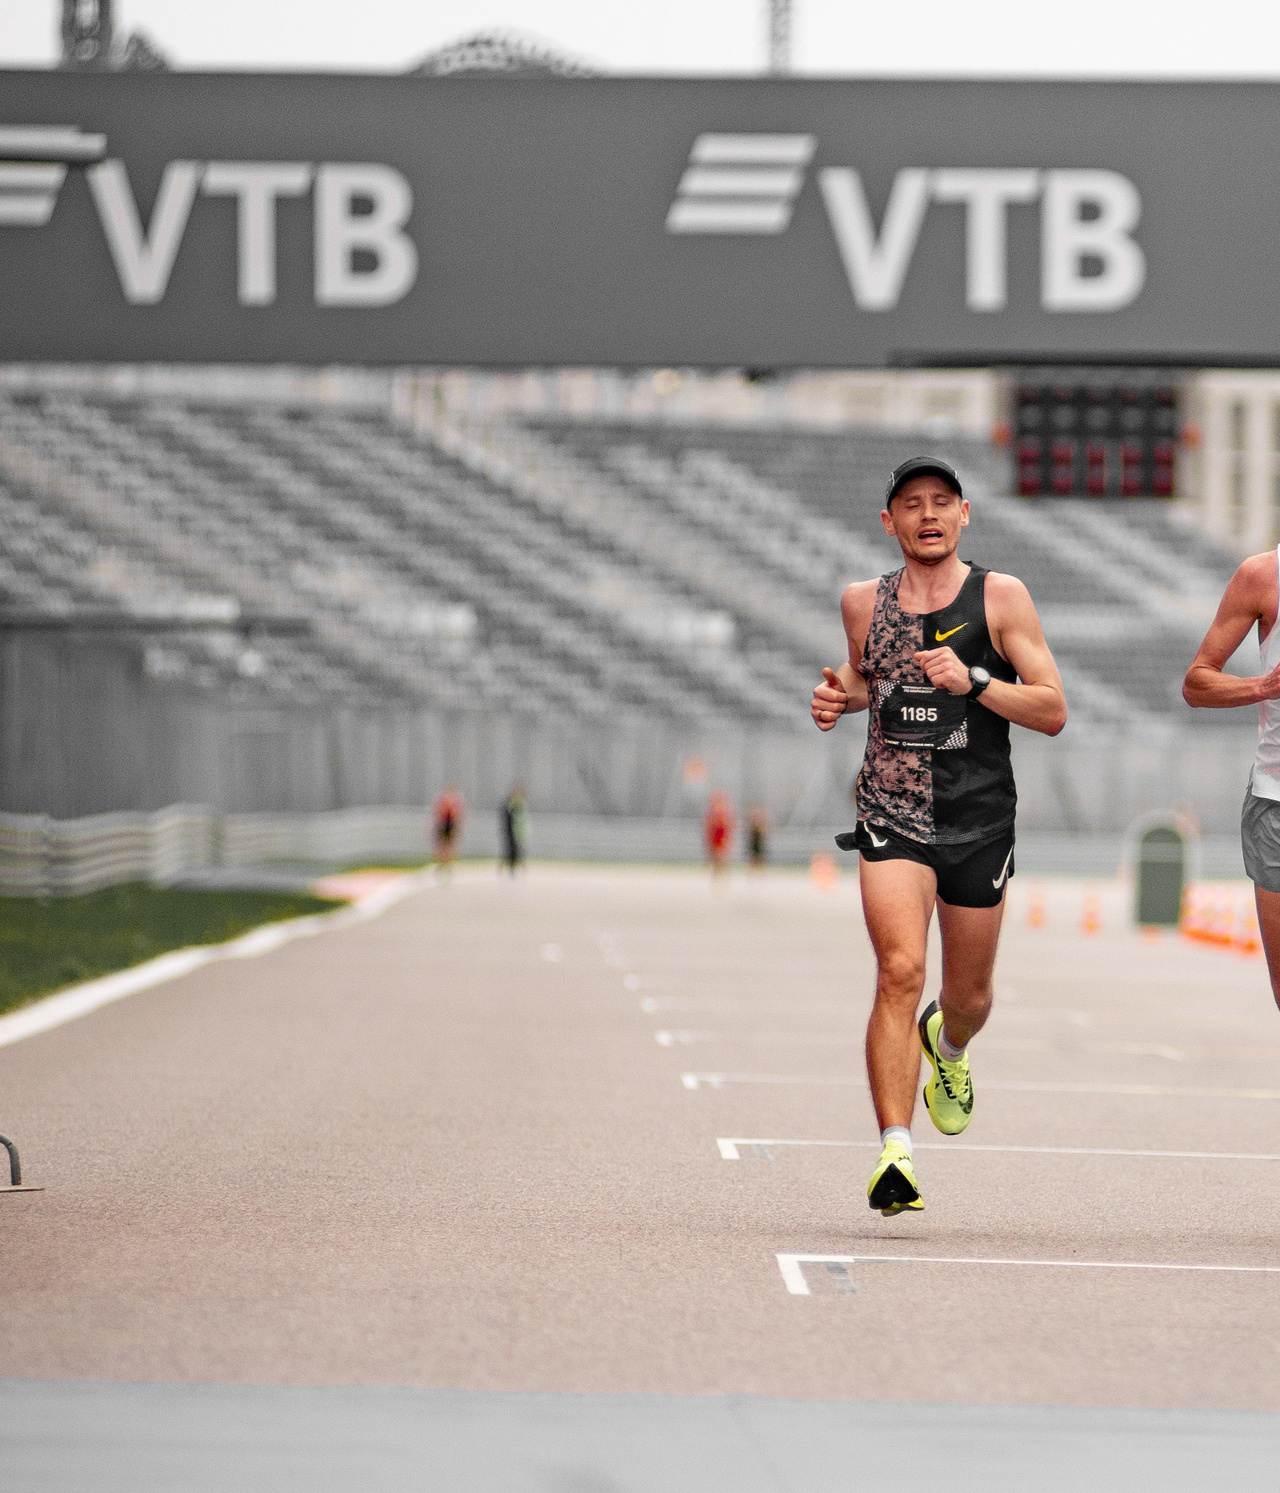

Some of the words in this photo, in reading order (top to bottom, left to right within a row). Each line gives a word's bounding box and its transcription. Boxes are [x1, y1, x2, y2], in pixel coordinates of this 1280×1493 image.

[88, 164, 416, 304] VTB
[819, 167, 1146, 312] VTB
[900, 706, 938, 722] 1185
